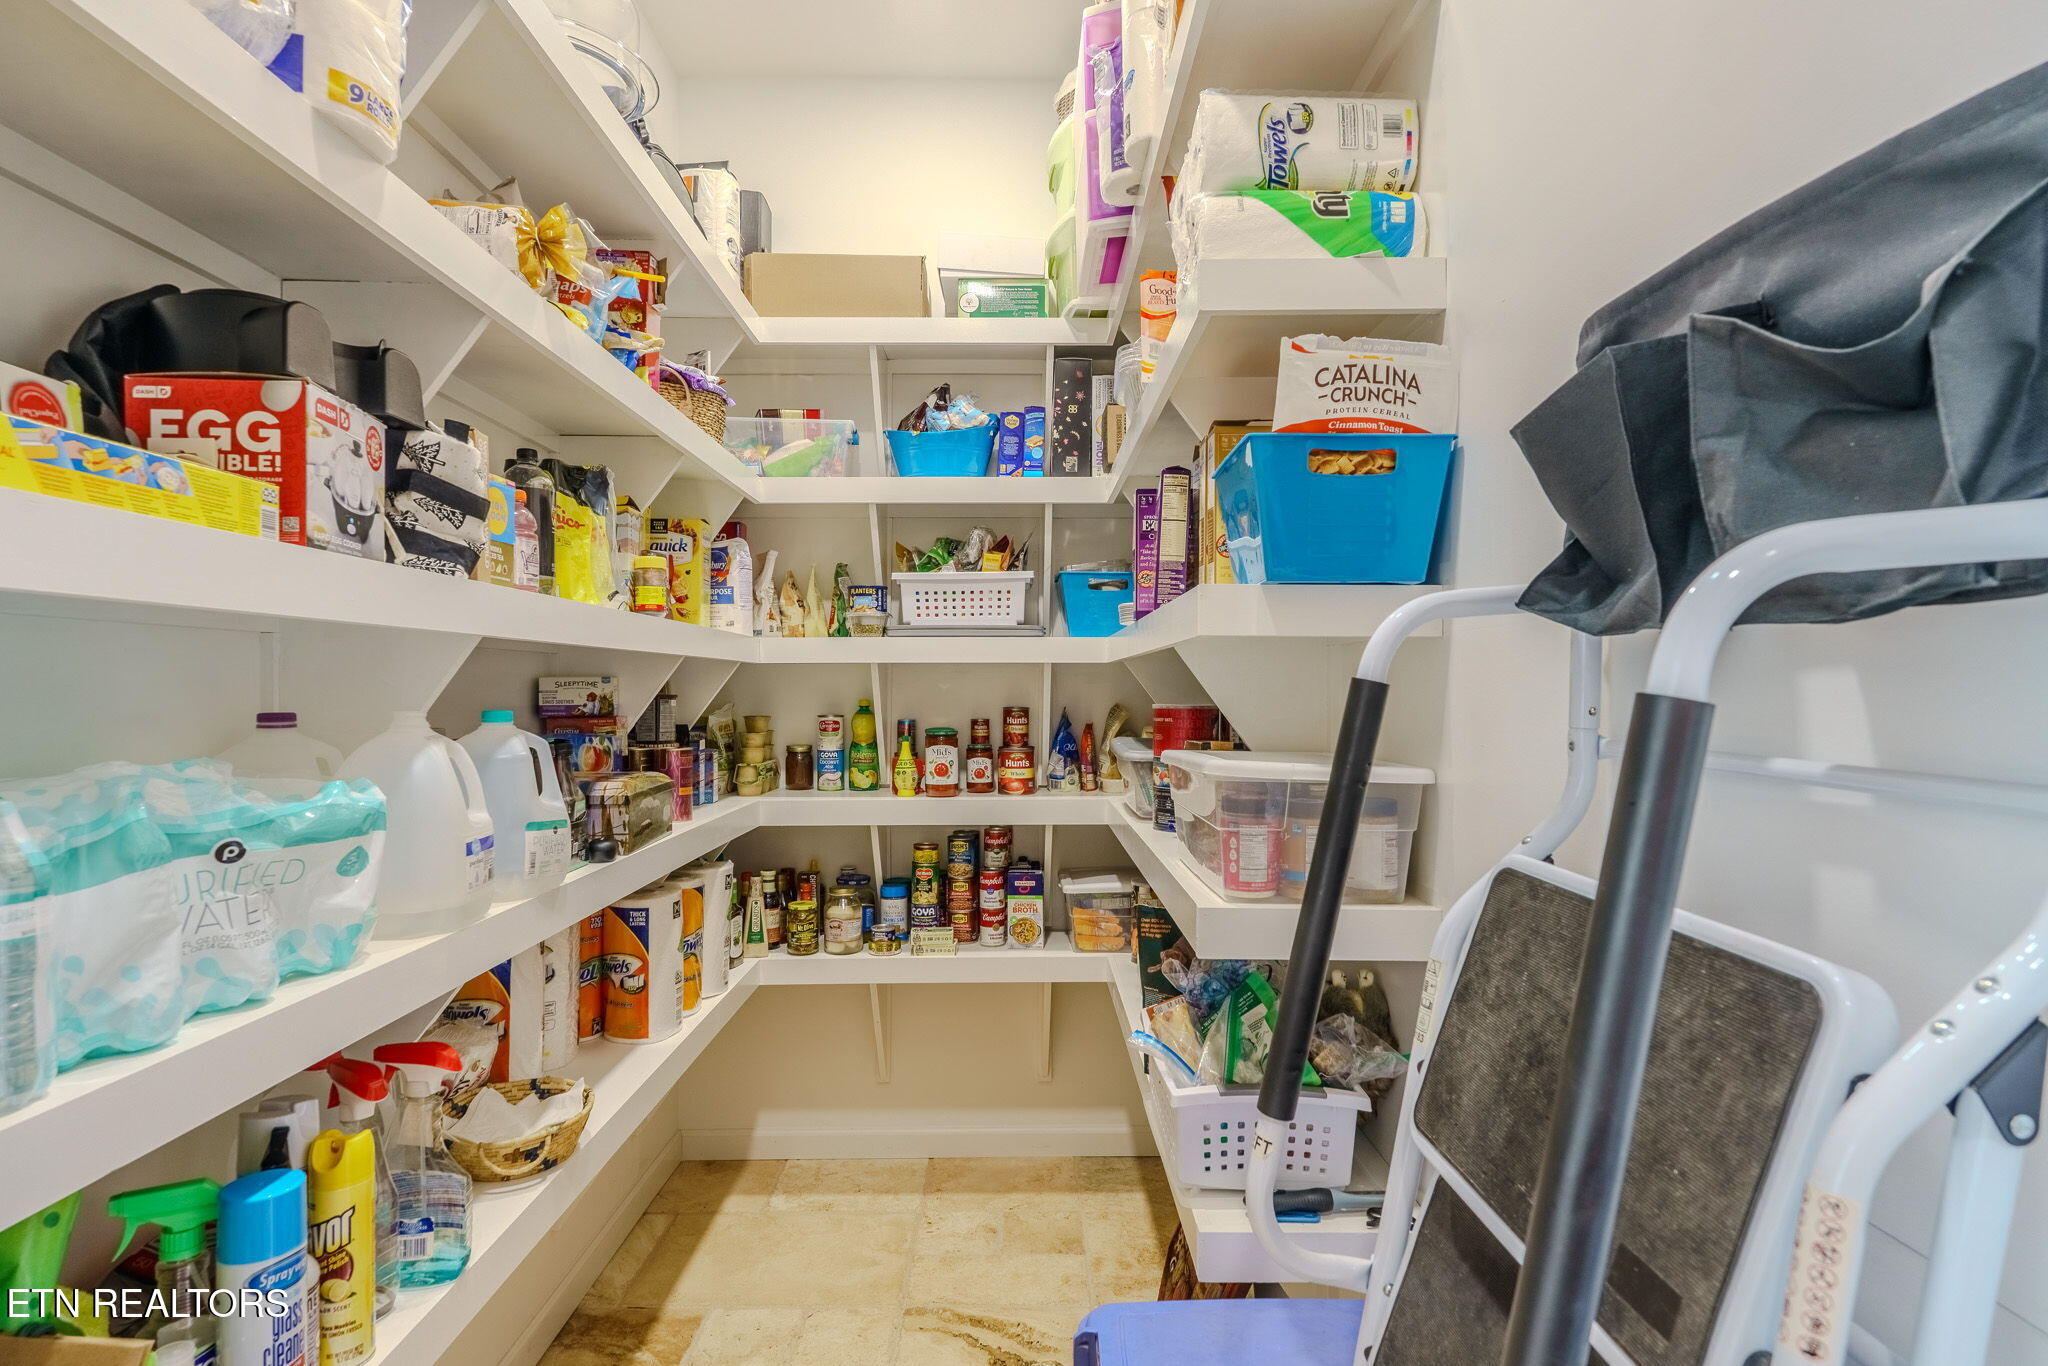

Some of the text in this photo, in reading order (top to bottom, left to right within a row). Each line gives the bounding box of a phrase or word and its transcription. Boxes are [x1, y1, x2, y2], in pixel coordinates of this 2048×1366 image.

[349, 84, 364, 103] 9
[1266, 117, 1289, 190] Towels
[1314, 363, 1421, 395] CATALINA
[1330, 386, 1405, 407] CRUNCH
[316, 402, 337, 420] DASH
[1325, 406, 1411, 420] PROTEIN CEREAL
[150, 409, 281, 453] EGG
[1328, 420, 1404, 434] Cinnamon Toast
[218, 454, 281, 472] IBLE!
[554, 680, 599, 689] SLEEPYTIME
[178, 858, 306, 906] URIFIED
[181, 888, 282, 935] ATER
[912, 907, 935, 916] GOYA
[602, 959, 631, 974] owels
[1253, 1135, 1273, 1155] FT
[328, 1257, 349, 1272] Polish
[259, 1263, 304, 1288] Spray
[333, 1303, 352, 1313] SCENT
[273, 1297, 302, 1342] glass
